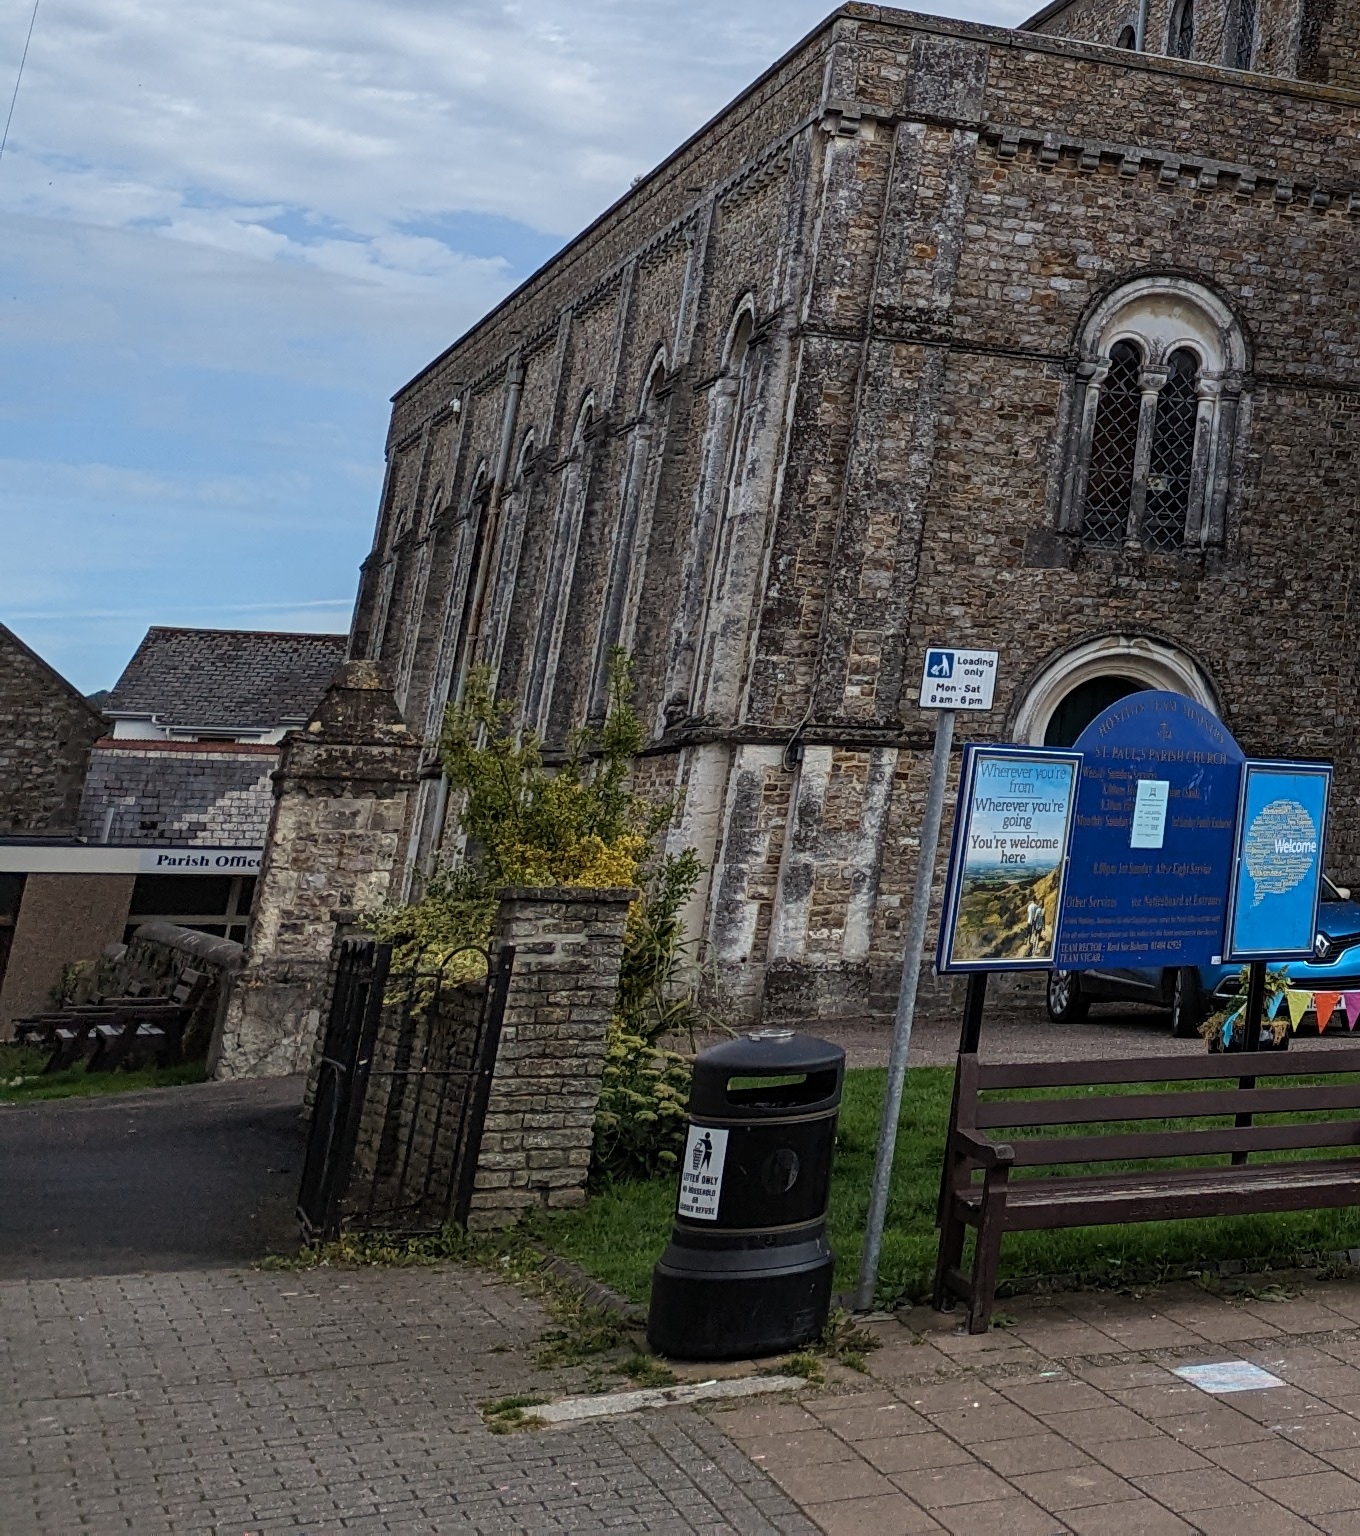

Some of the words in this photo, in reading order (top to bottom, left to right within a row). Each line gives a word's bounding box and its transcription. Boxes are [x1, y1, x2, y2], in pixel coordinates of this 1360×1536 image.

[957, 657, 994, 667] Loading
[964, 668, 984, 677] only
[936, 683, 956, 692] Mon
[964, 685, 981, 693] Sat
[930, 695, 937, 703] 8
[960, 696, 966, 704] 6
[1149, 749, 1184, 762] PARISH
[1186, 750, 1227, 765] CHURCH
[980, 762, 1034, 778] Wherever
[1035, 766, 1067, 781] you're
[1009, 779, 1035, 793] from
[975, 798, 1031, 813] Wherever
[1031, 799, 1065, 815] you're
[1002, 814, 1033, 830] going
[971, 835, 1007, 849] You're
[1009, 835, 1059, 849] welcome
[1275, 839, 1317, 854] Welcome
[156, 854, 210, 867] Parish
[1000, 850, 1026, 864] here
[702, 1175, 719, 1185] ONLY
